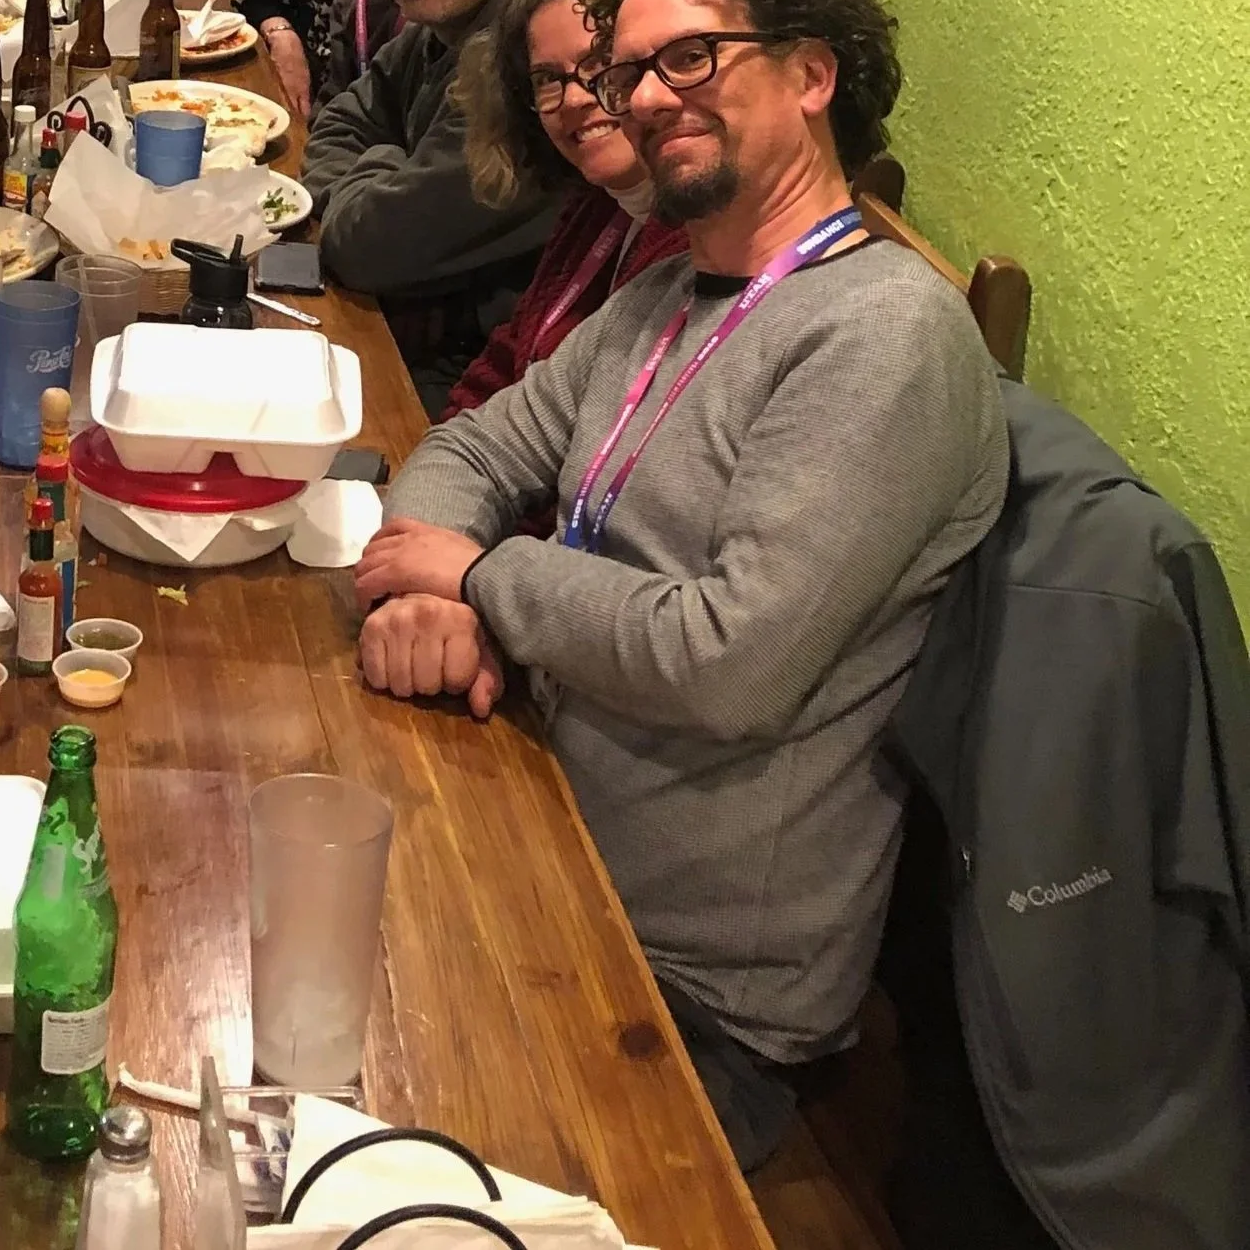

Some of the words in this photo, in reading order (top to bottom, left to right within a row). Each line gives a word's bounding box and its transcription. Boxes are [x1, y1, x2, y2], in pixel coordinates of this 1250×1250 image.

[796, 219, 845, 255] SUNDANCE
[738, 272, 772, 310] UTAH
[1026, 865, 1114, 907] Columbia
